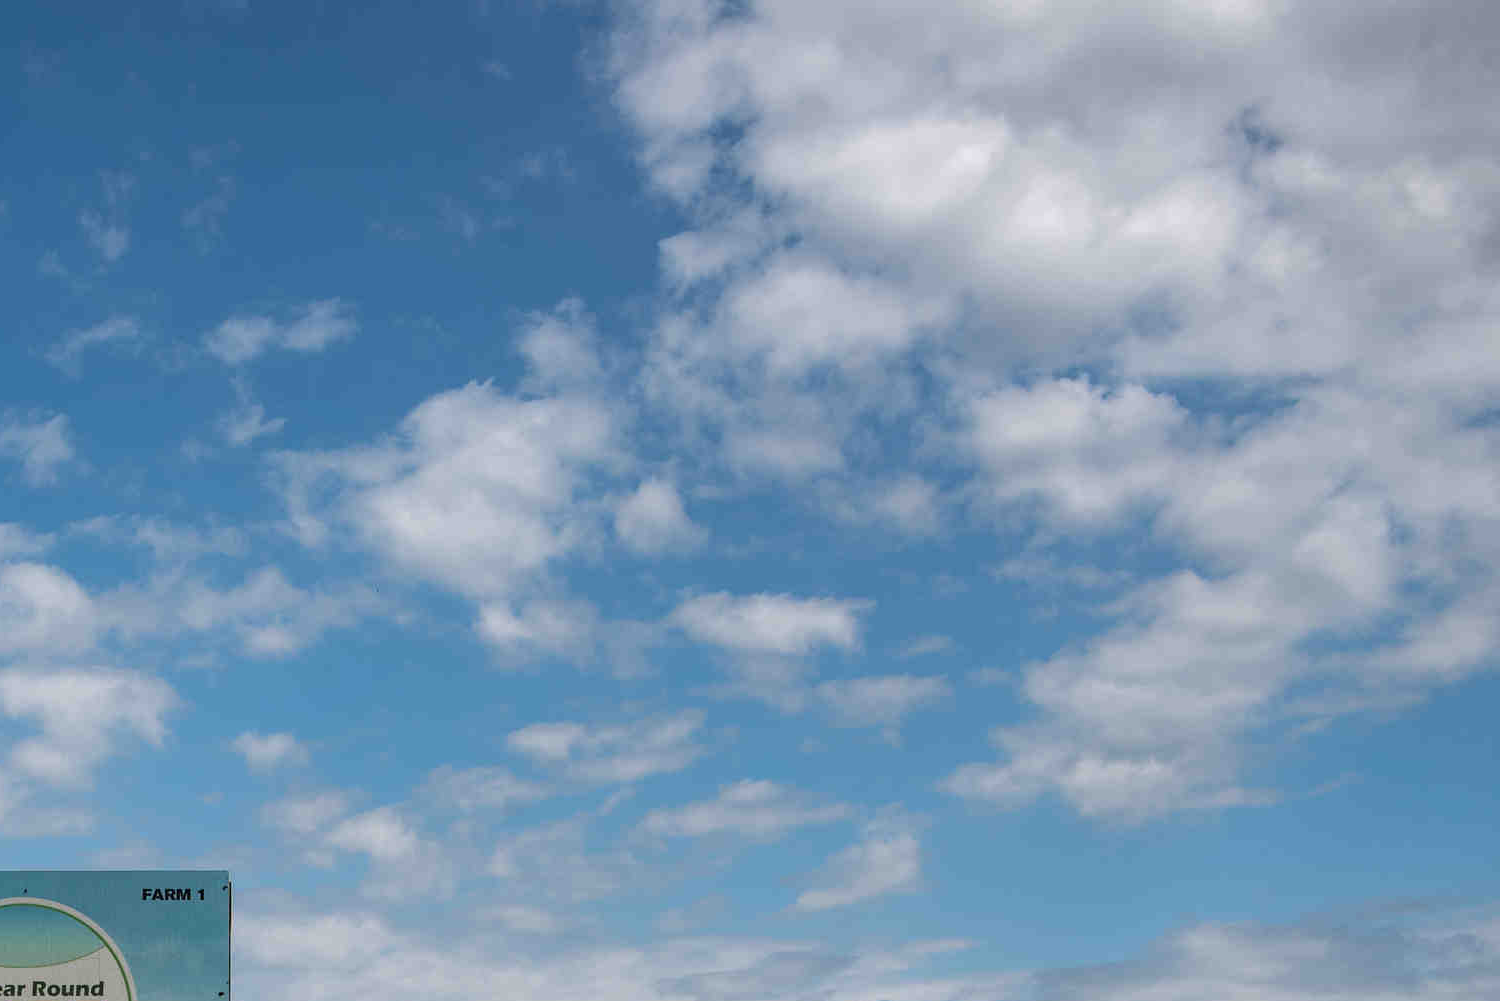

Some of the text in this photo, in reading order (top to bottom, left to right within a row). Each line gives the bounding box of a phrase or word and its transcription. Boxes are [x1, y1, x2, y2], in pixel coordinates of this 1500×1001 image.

[142, 888, 205, 901] FARM 1
[32, 981, 104, 997] Round
